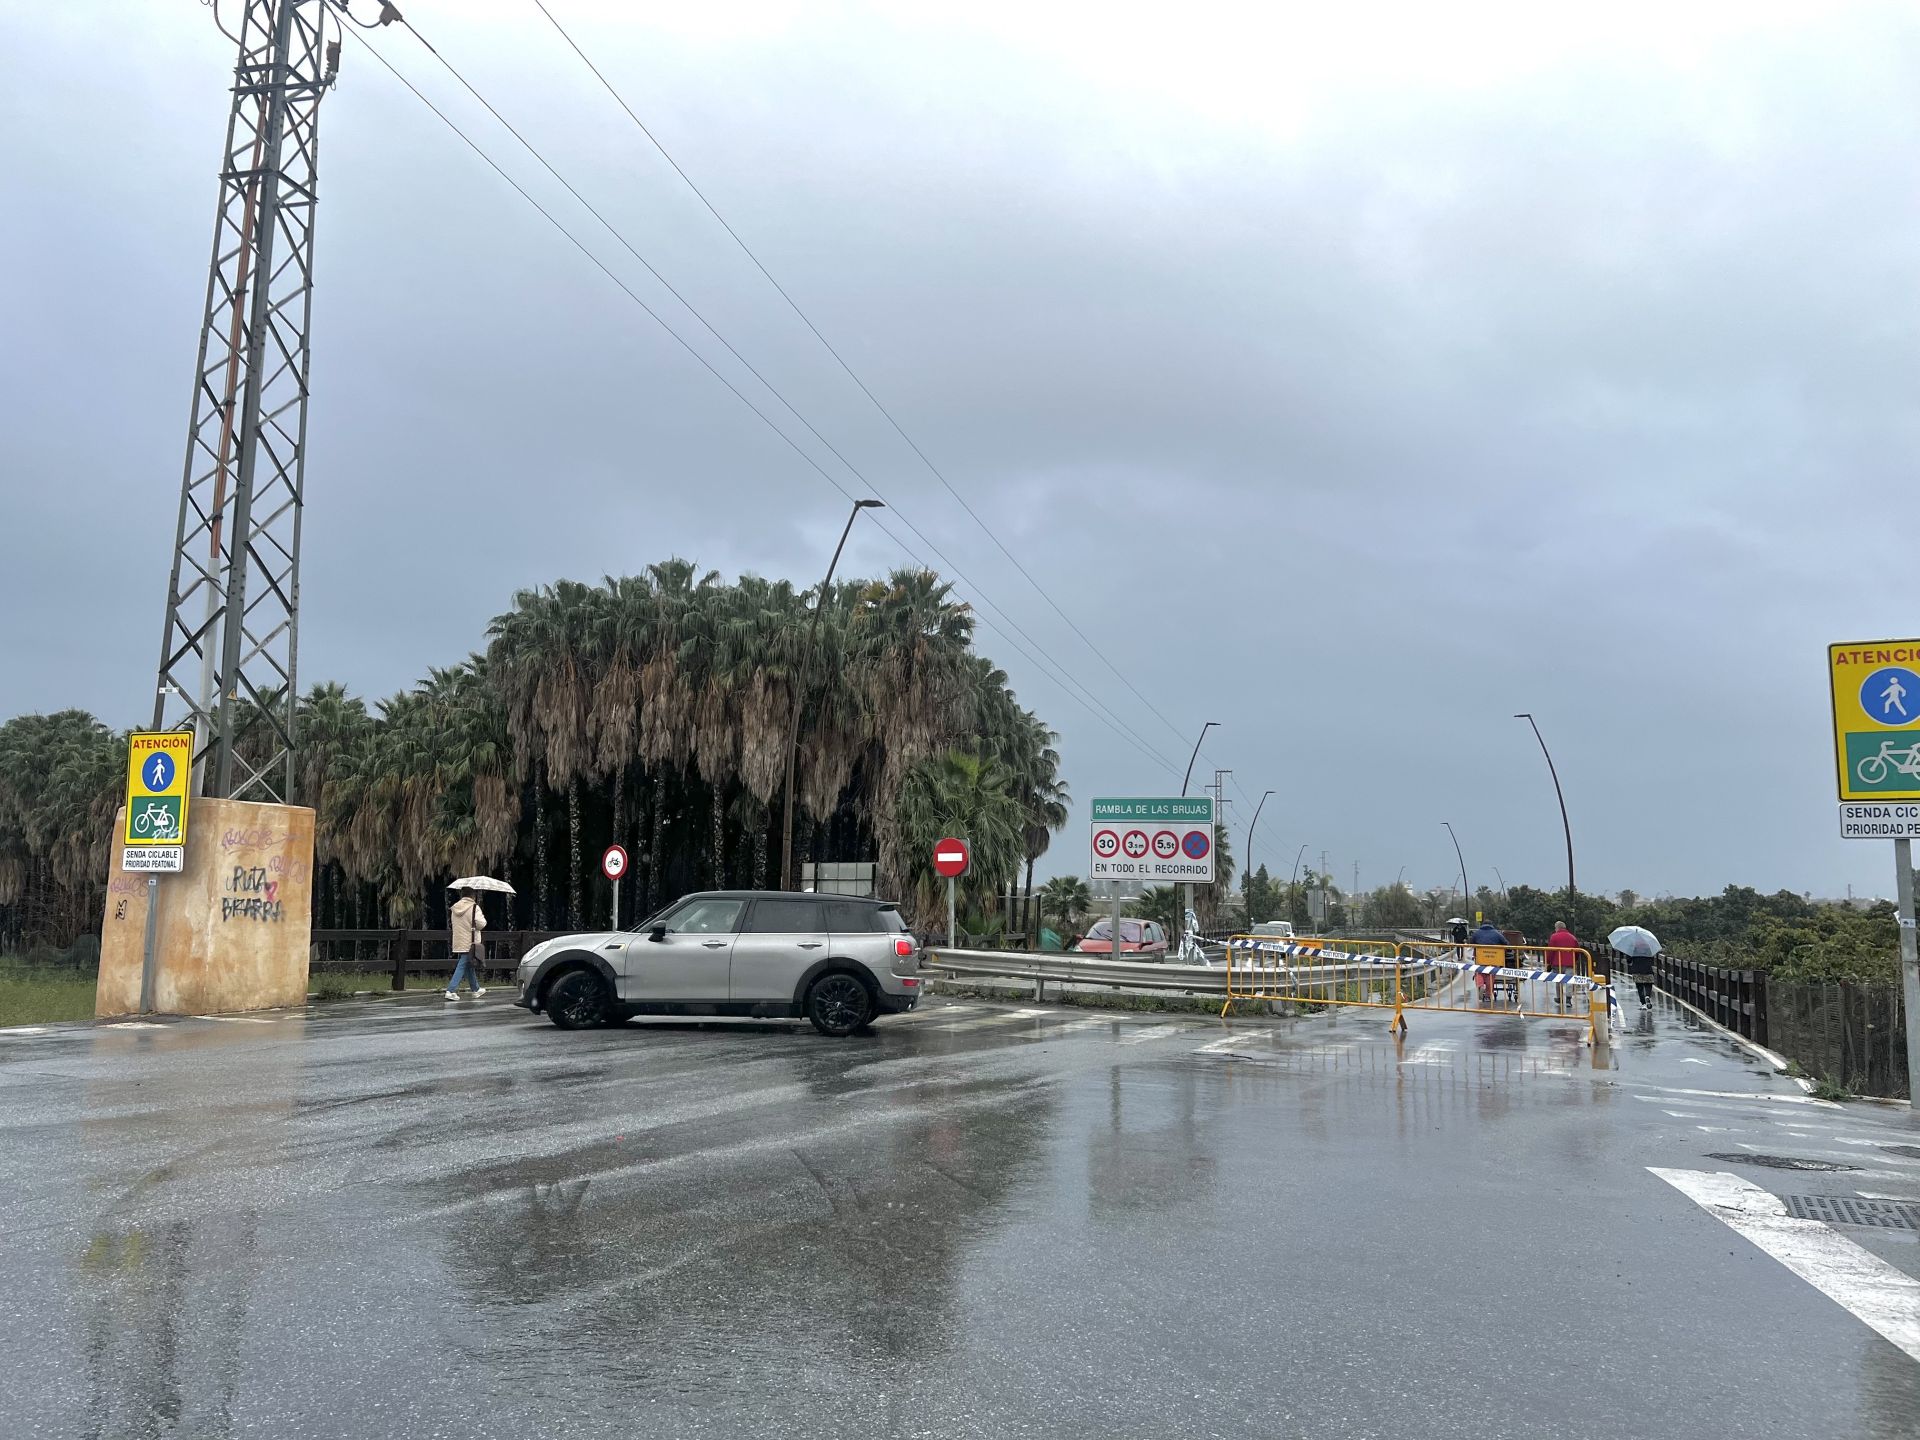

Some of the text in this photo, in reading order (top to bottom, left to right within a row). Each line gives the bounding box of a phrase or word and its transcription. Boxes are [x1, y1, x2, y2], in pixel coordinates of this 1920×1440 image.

[1836, 649, 1920, 665] ATENCI
[133, 737, 188, 749] ATENCIÓN
[1095, 805, 1208, 814] RAMBLA DE LAS BRUJAS
[1846, 807, 1919, 818] SENDA CIC
[1846, 823, 1904, 834] PRIORIDAD
[1098, 839, 1115, 849] 30
[1157, 839, 1175, 850] 5,5t
[126, 850, 178, 859] SENDA CICLABLE
[125, 860, 177, 868] PRIORIDAD PEATONAL
[1095, 863, 1208, 874] EN TODO EL RECORRIDO
